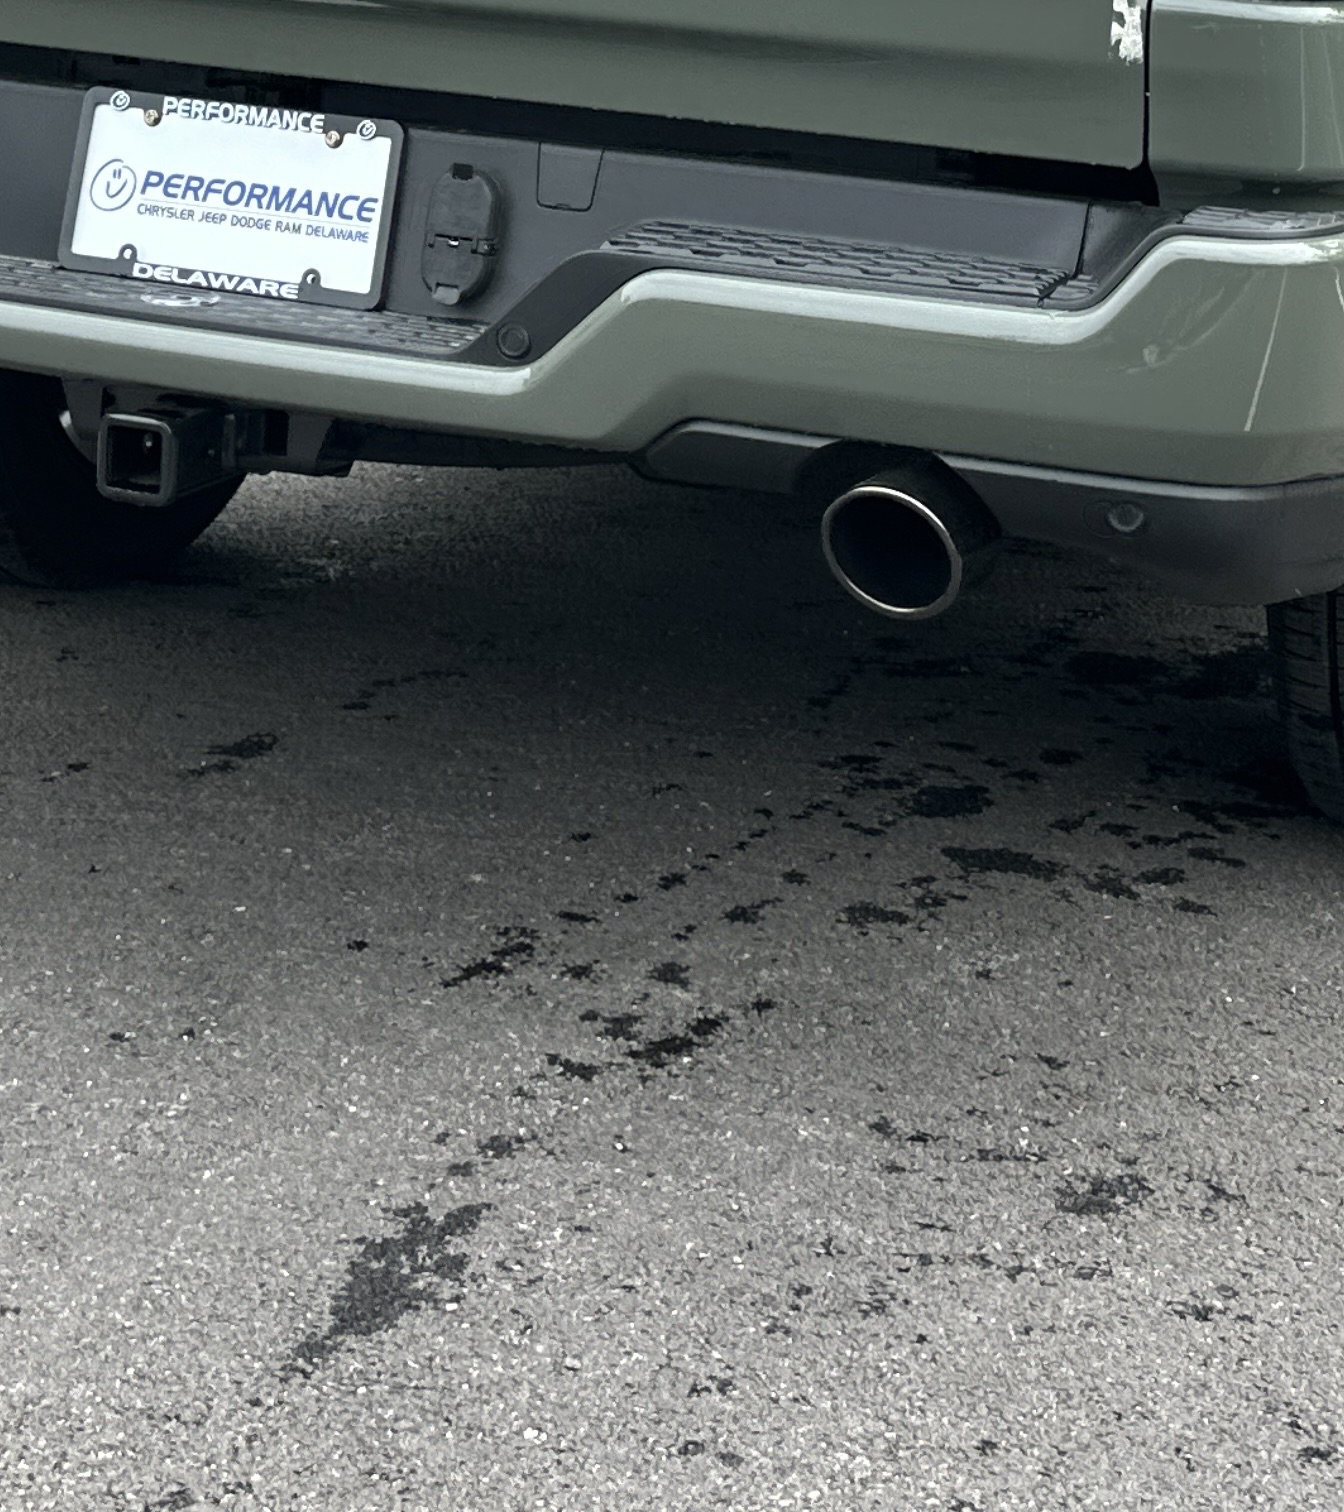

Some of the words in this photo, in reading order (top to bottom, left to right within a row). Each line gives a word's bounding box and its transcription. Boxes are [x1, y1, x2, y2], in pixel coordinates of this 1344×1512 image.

[162, 96, 325, 135] PERFORMANCE
[140, 170, 379, 223] PERFORMANCE
[136, 202, 195, 222] CHRYSLER
[198, 212, 227, 225] JEEP
[230, 215, 272, 232] DODGE
[275, 220, 302, 236] RAM
[305, 224, 370, 244] DELAWARE
[131, 262, 300, 300] DELAWARE
